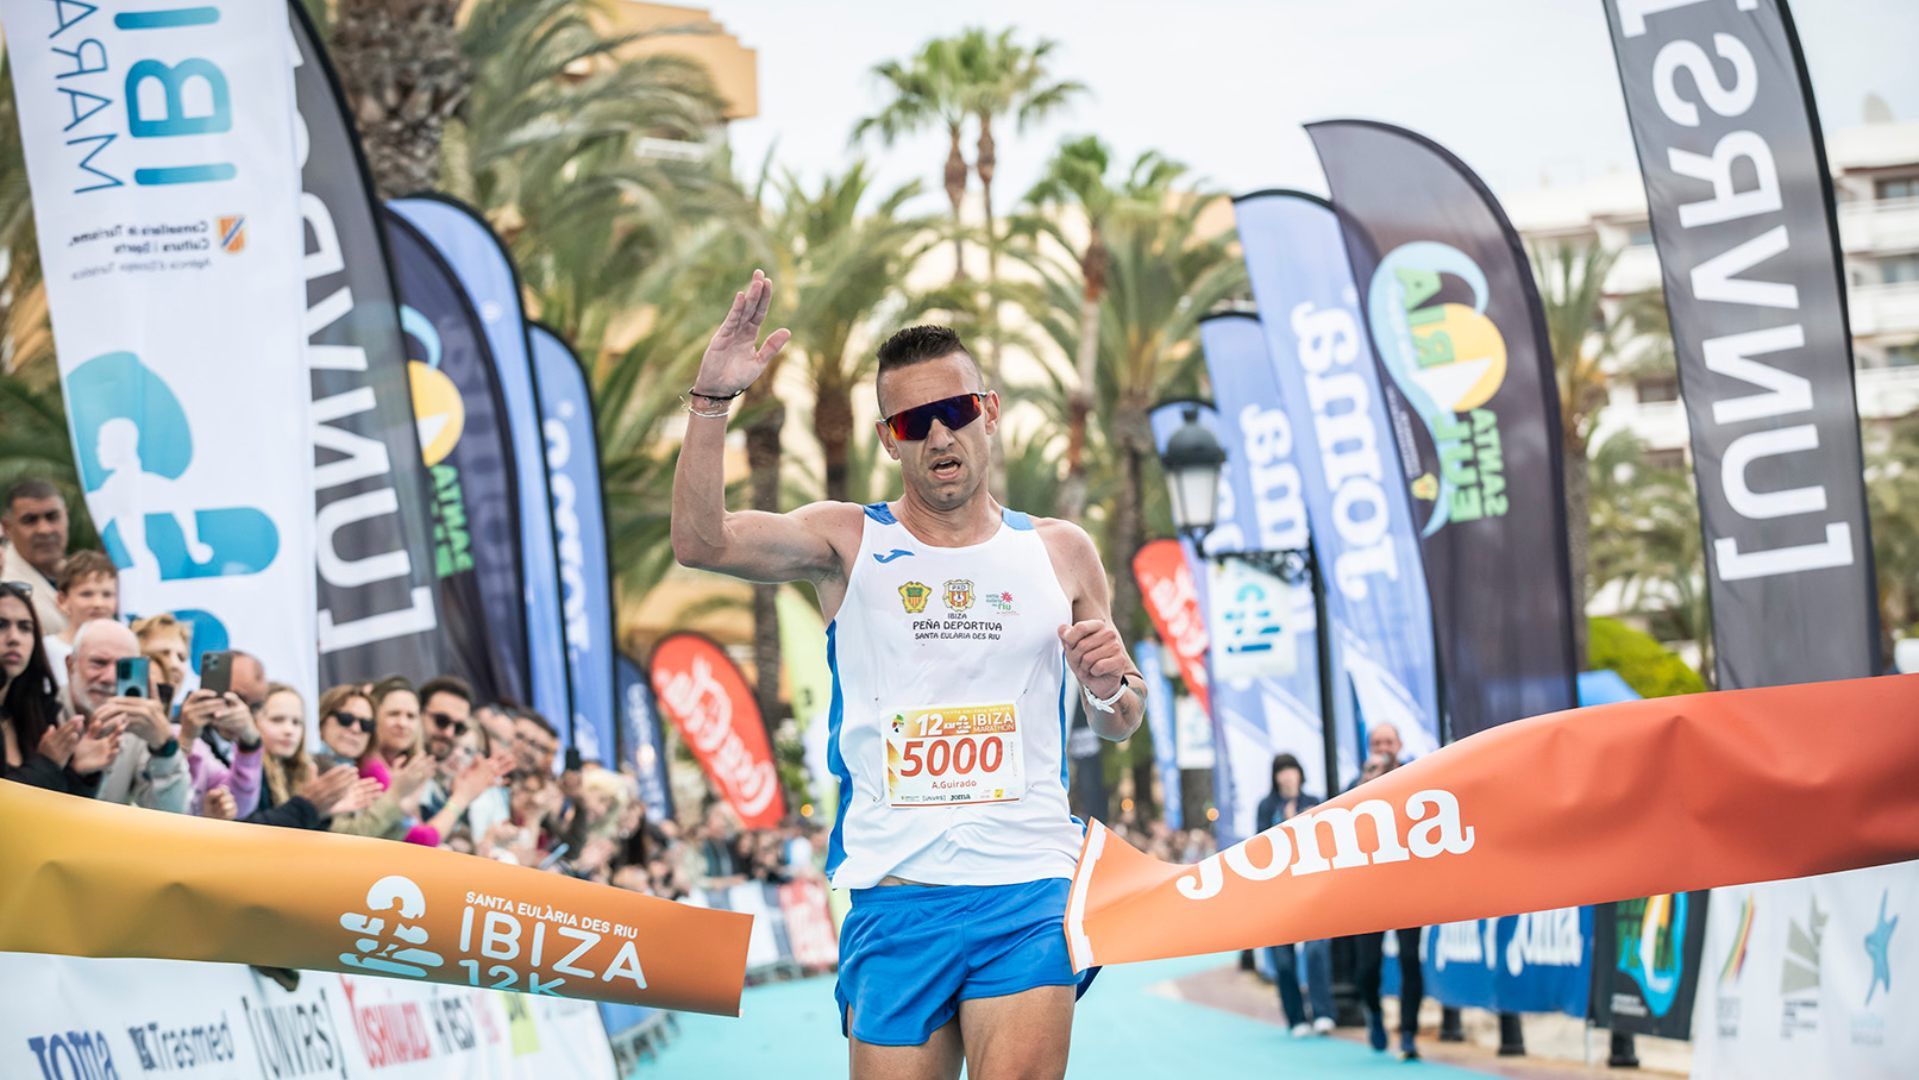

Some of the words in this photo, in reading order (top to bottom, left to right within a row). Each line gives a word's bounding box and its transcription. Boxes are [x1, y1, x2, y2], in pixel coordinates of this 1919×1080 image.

[913, 619, 941, 630] PEÑA
[943, 620, 1003, 631] DEPORTIVA
[915, 632, 939, 640] SANTA
[972, 632, 986, 640] DES
[916, 713, 944, 737] 12
[972, 711, 1014, 727] IBIZA
[900, 736, 1004, 777] 5000
[931, 779, 977, 790] A.Guirado
[465, 890, 514, 913] SANTA
[517, 901, 578, 927] EULÀRIA
[581, 916, 610, 934] DES
[613, 923, 639, 940] RIU
[459, 905, 648, 990] IBIZA
[459, 959, 567, 998] 12K
[147, 1008, 236, 1071] Trasmed
